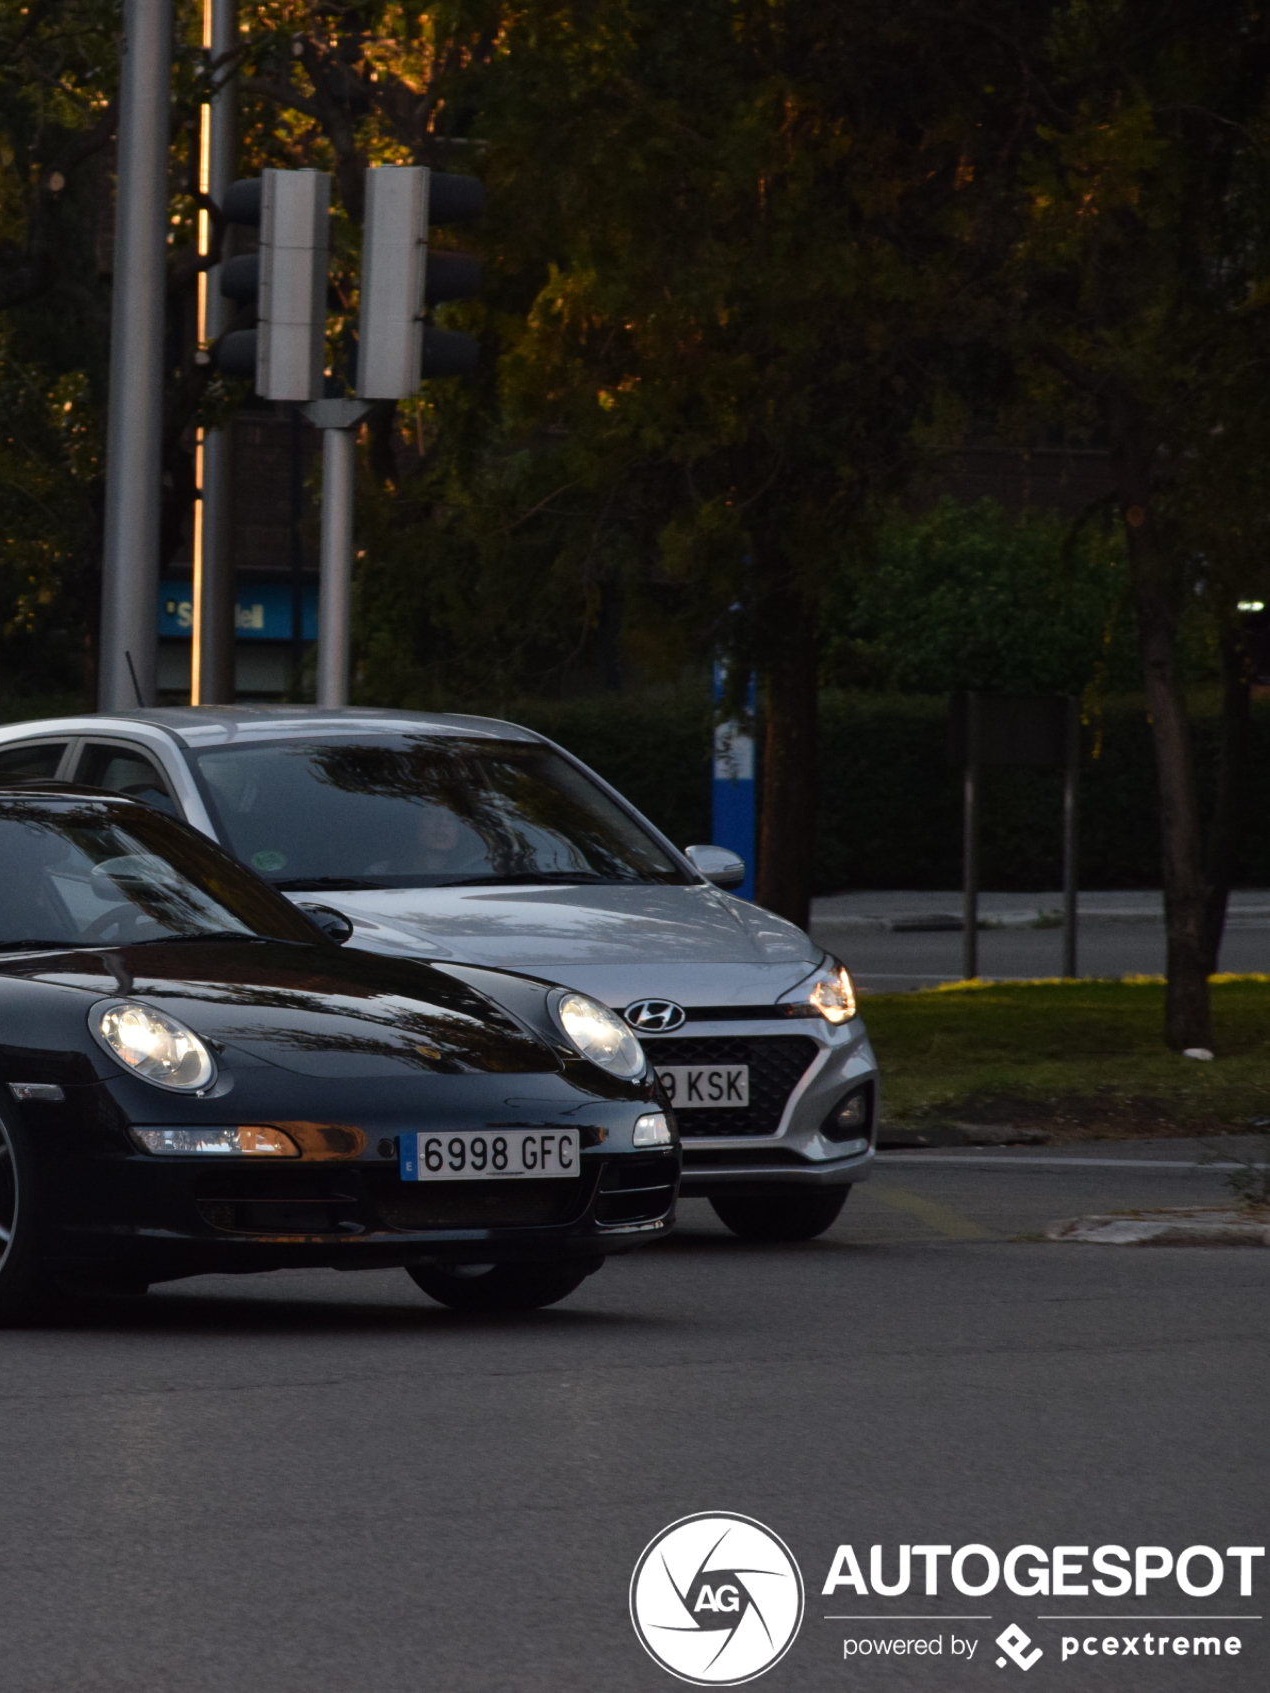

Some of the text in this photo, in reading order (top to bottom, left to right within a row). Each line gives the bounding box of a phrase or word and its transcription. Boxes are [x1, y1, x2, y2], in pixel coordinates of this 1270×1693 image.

[688, 1071, 743, 1101] KSK
[405, 1161, 413, 1171] E
[424, 1135, 573, 1172] 6998 GFC
